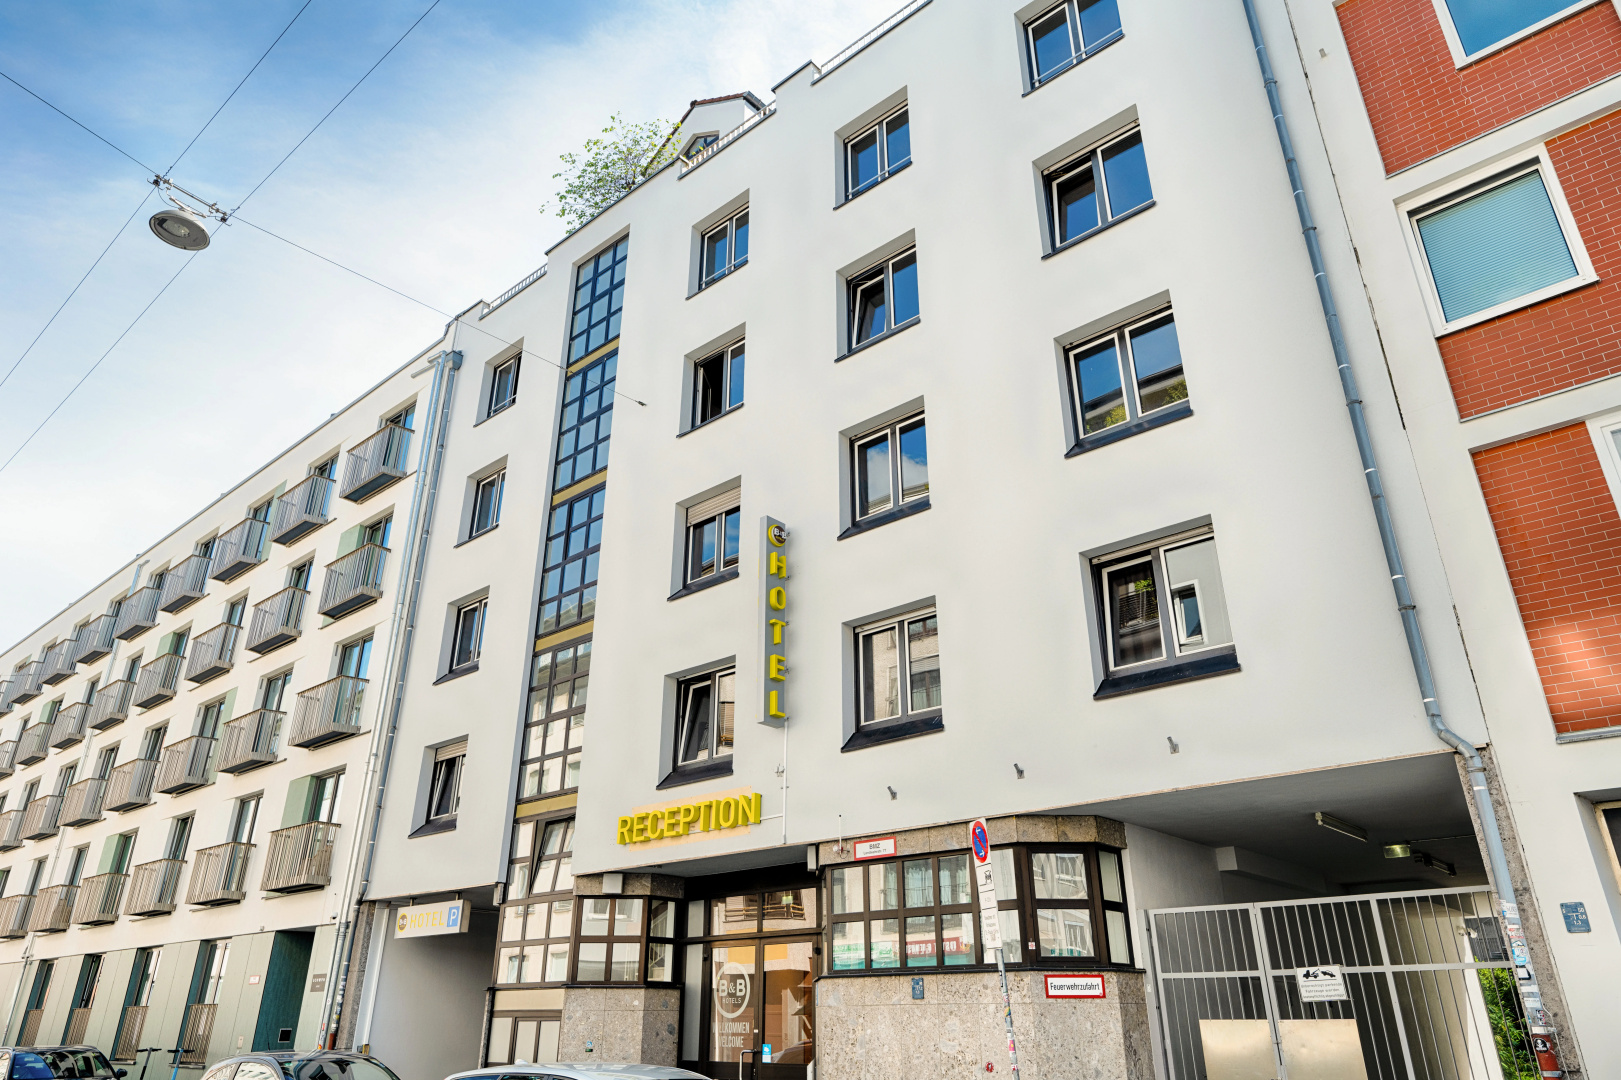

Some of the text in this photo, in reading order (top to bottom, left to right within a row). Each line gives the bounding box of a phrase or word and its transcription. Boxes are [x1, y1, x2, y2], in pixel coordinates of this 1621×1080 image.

[769, 551, 787, 718] HOTEL
[616, 792, 762, 845] RECEPTION
[410, 910, 444, 928] HOTEL
[719, 979, 746, 997] B&B
[1050, 982, 1100, 991] Feuerwehrzufahrt
